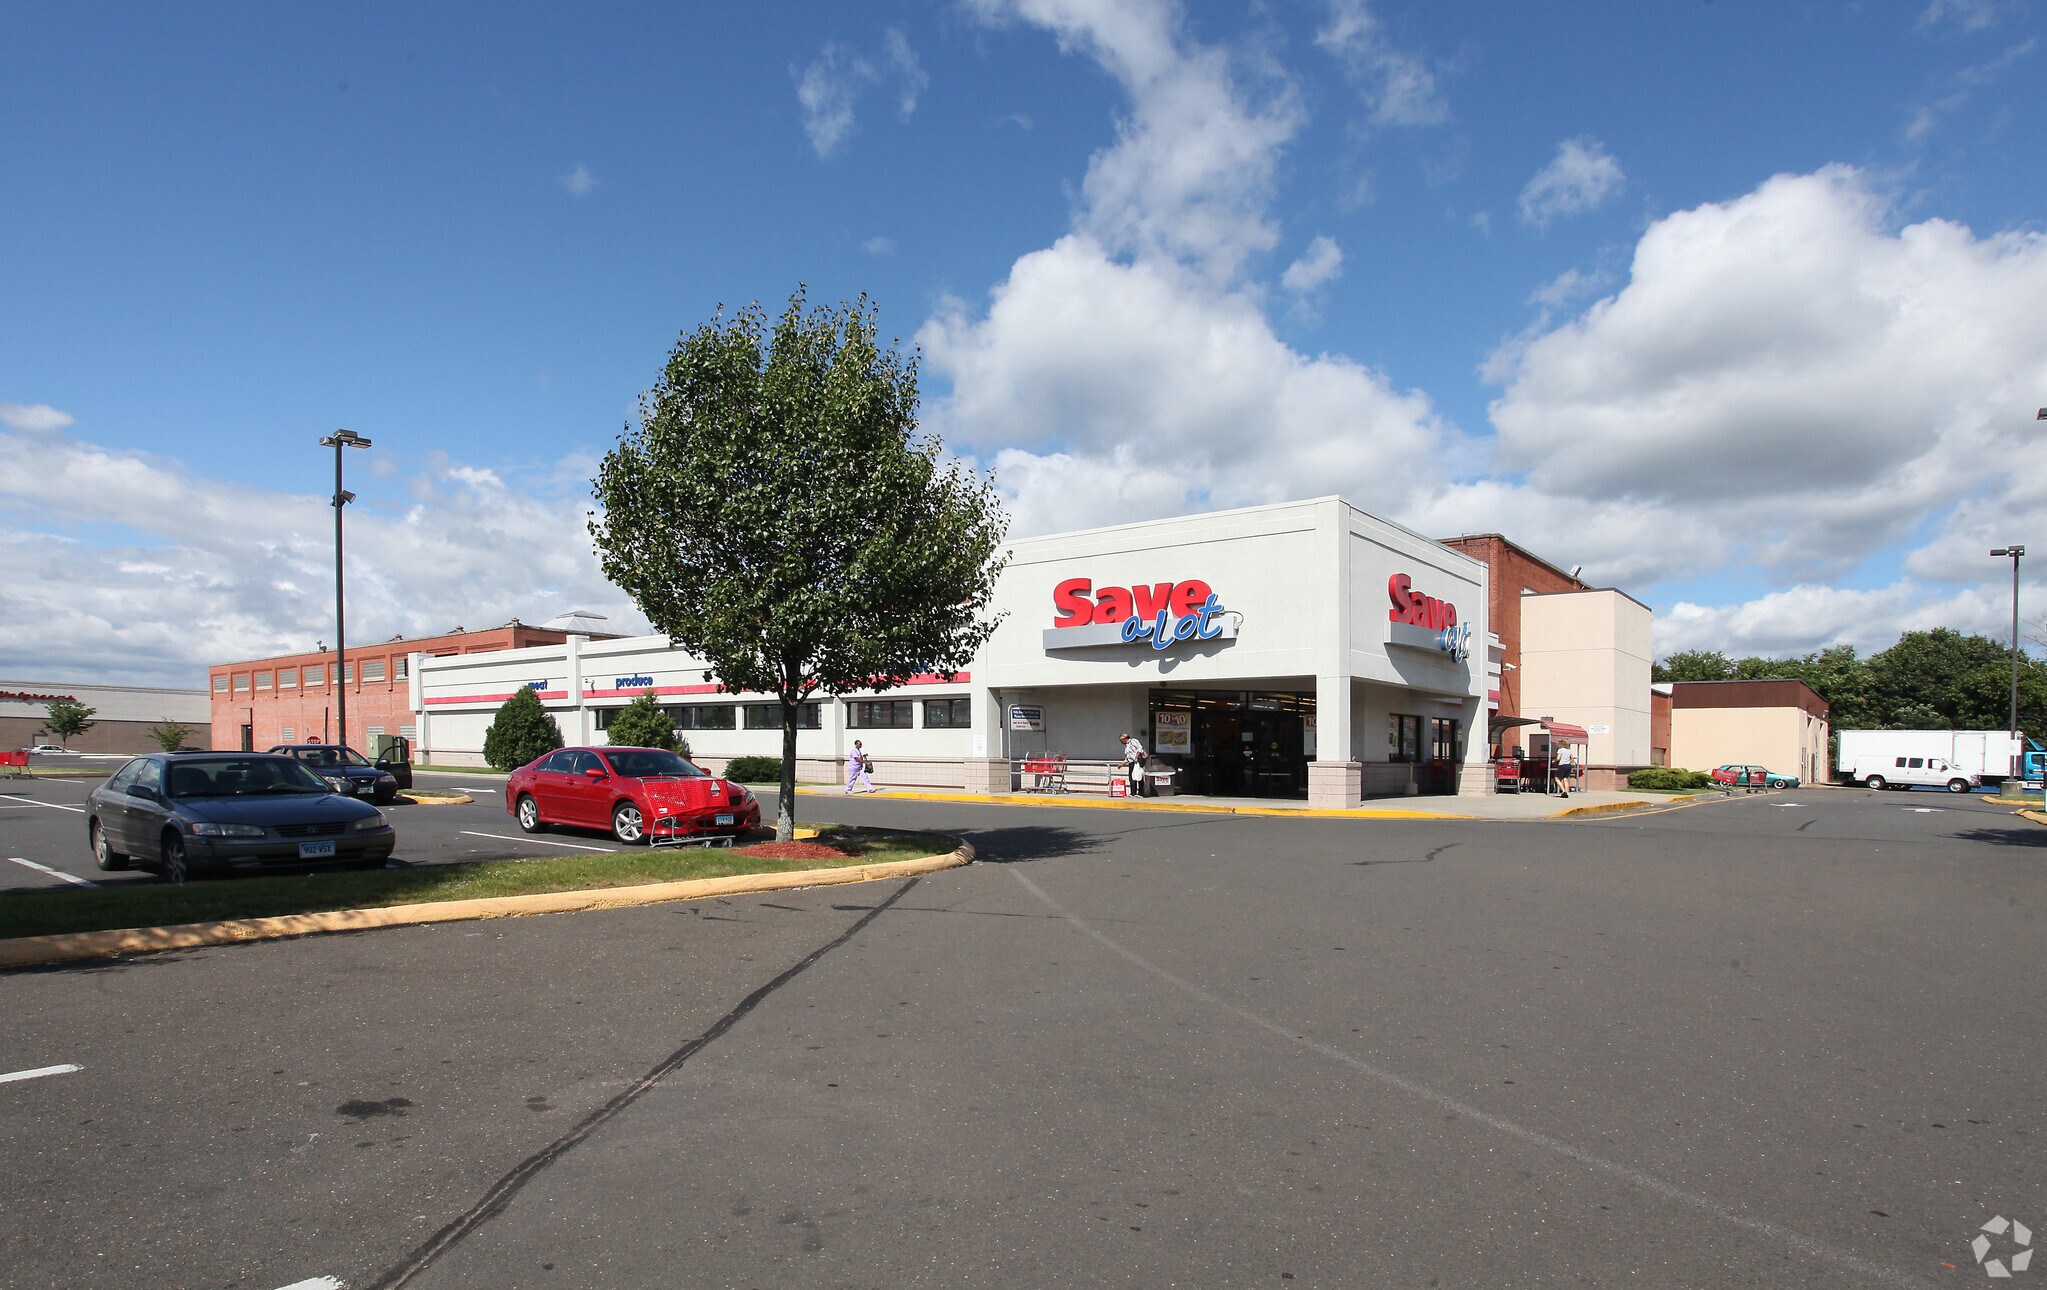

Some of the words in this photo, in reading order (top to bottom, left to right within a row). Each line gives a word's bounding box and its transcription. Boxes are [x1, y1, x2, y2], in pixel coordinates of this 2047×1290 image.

[1053, 578, 1212, 628] Save
[1388, 573, 1457, 631] Save
[615, 673, 653, 691] produce
[1160, 713, 1171, 724] 10
